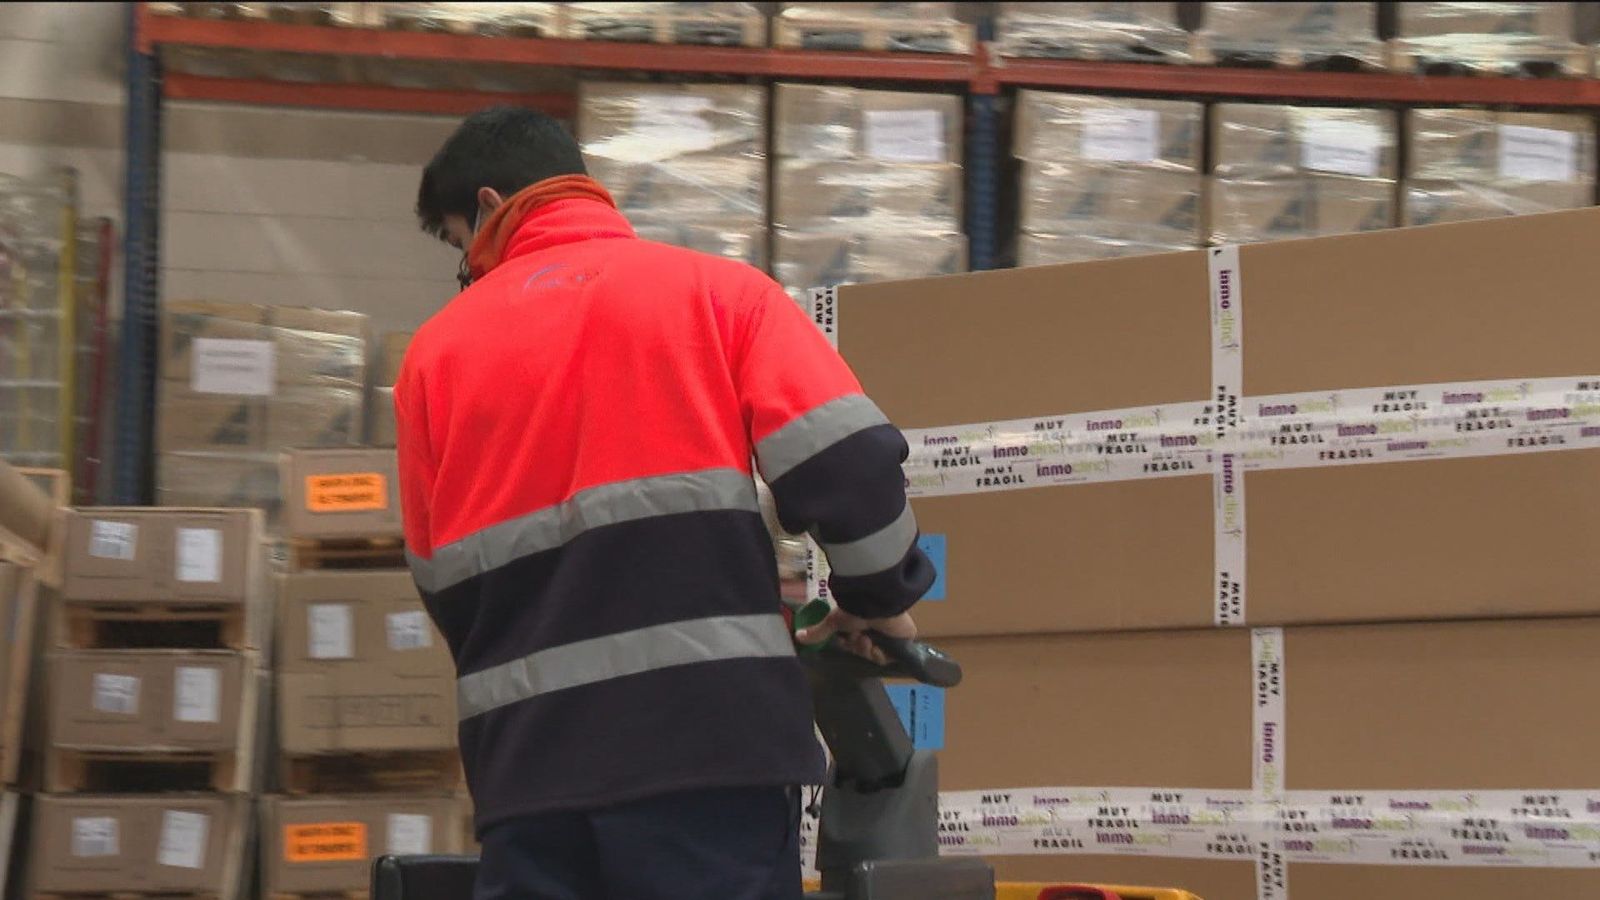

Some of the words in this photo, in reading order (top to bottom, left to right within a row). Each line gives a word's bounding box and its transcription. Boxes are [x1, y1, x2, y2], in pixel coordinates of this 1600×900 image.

[815, 293, 823, 324] MUY
[825, 290, 833, 333] FRAGI
[1384, 391, 1417, 400] MUY
[1217, 385, 1226, 438] FRAGIL
[1228, 395, 1237, 427] MUY
[1373, 402, 1428, 412] FRAGIL
[1034, 420, 1064, 431] MUY
[1280, 422, 1313, 433] MUY
[1106, 433, 1137, 443] MUY
[1271, 434, 1325, 446] FRAGIL
[942, 445, 971, 456] MUY
[1097, 444, 1148, 454] FRAGIL
[1319, 449, 1374, 461] FRAGIL
[933, 456, 981, 469] FRAGIL
[1143, 460, 1195, 473] FRAGIL
[984, 465, 1013, 475] MUY
[976, 474, 1025, 487] FRAGIL
[1231, 582, 1240, 616] MUY
[981, 794, 1011, 805] MUY
[1151, 792, 1183, 803] MUY
[1331, 795, 1364, 805] MUY
[1522, 795, 1559, 805] MUY
[1098, 806, 1129, 817] MUY
[938, 822, 970, 833] AGIL
[1087, 818, 1139, 829] FRAGIL
[1033, 838, 1084, 849] FRAGIL
